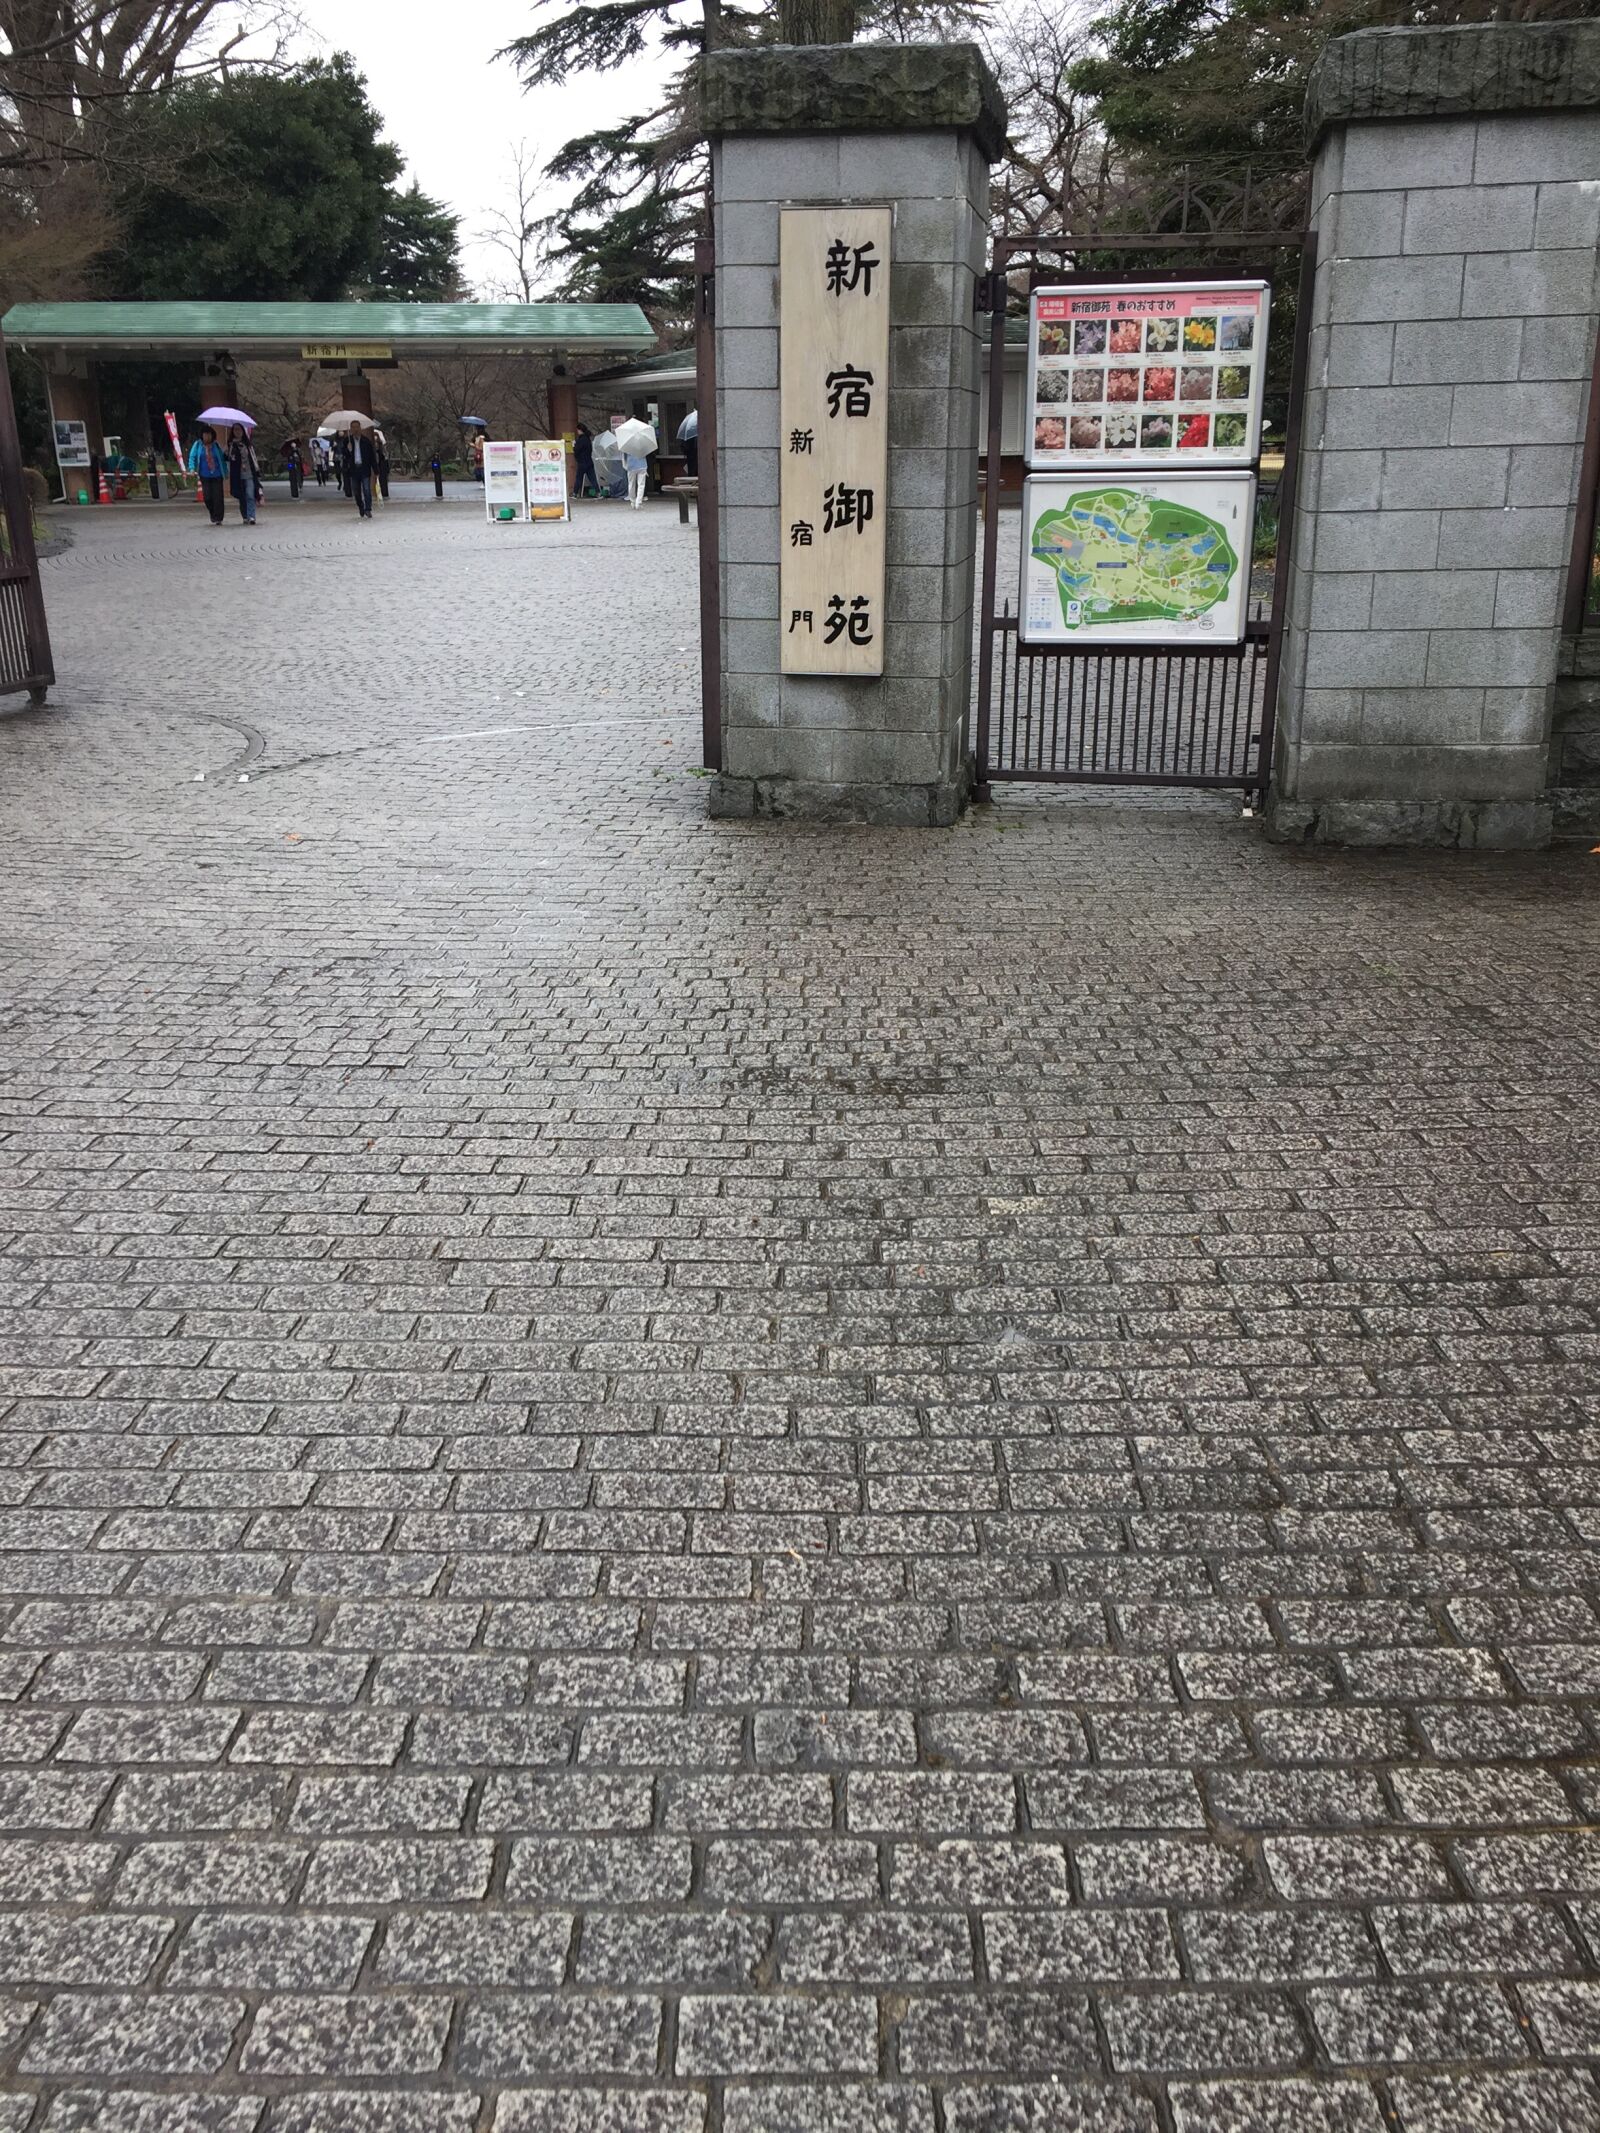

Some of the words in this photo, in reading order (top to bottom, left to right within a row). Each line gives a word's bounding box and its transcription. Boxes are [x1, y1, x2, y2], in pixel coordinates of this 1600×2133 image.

[307, 344, 346, 356] 新宿門
[1071, 300, 1111, 313] 新宿御苑
[1116, 299, 1176, 312] 春のおすすめ
[824, 239, 880, 645] 新宿御苑
[788, 428, 814, 634] 新宿門
